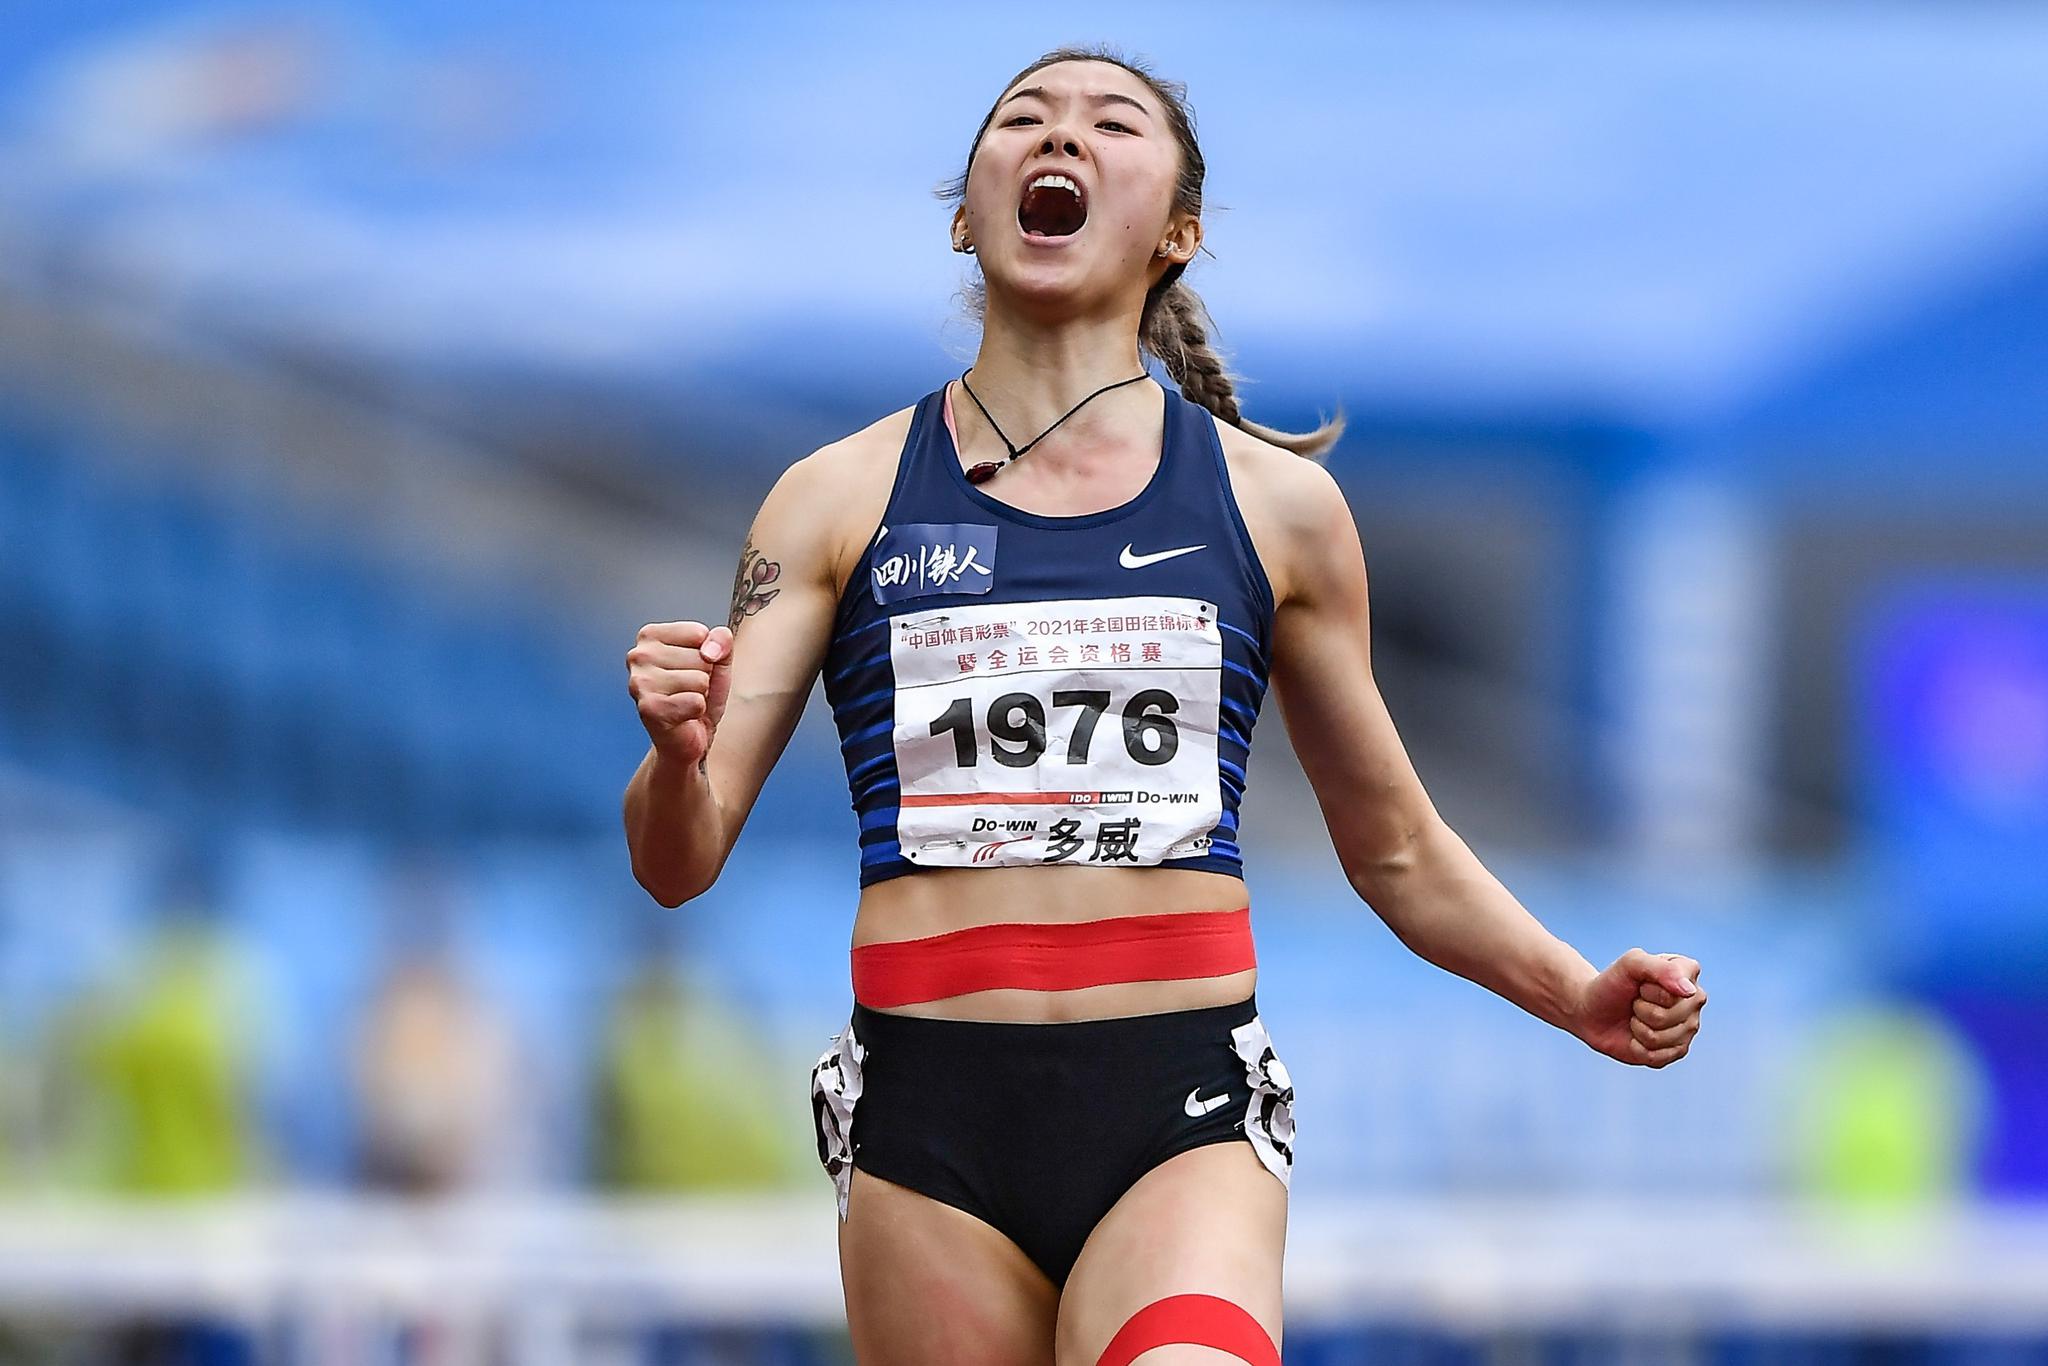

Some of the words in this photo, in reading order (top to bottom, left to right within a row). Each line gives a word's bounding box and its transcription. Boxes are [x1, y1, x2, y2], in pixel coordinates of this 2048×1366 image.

[872, 544, 992, 590] 四川铁人
[957, 643, 1162, 673] 暨全运会资格赛
[929, 689, 1180, 768] 1976
[1043, 817, 1142, 863] 多威
